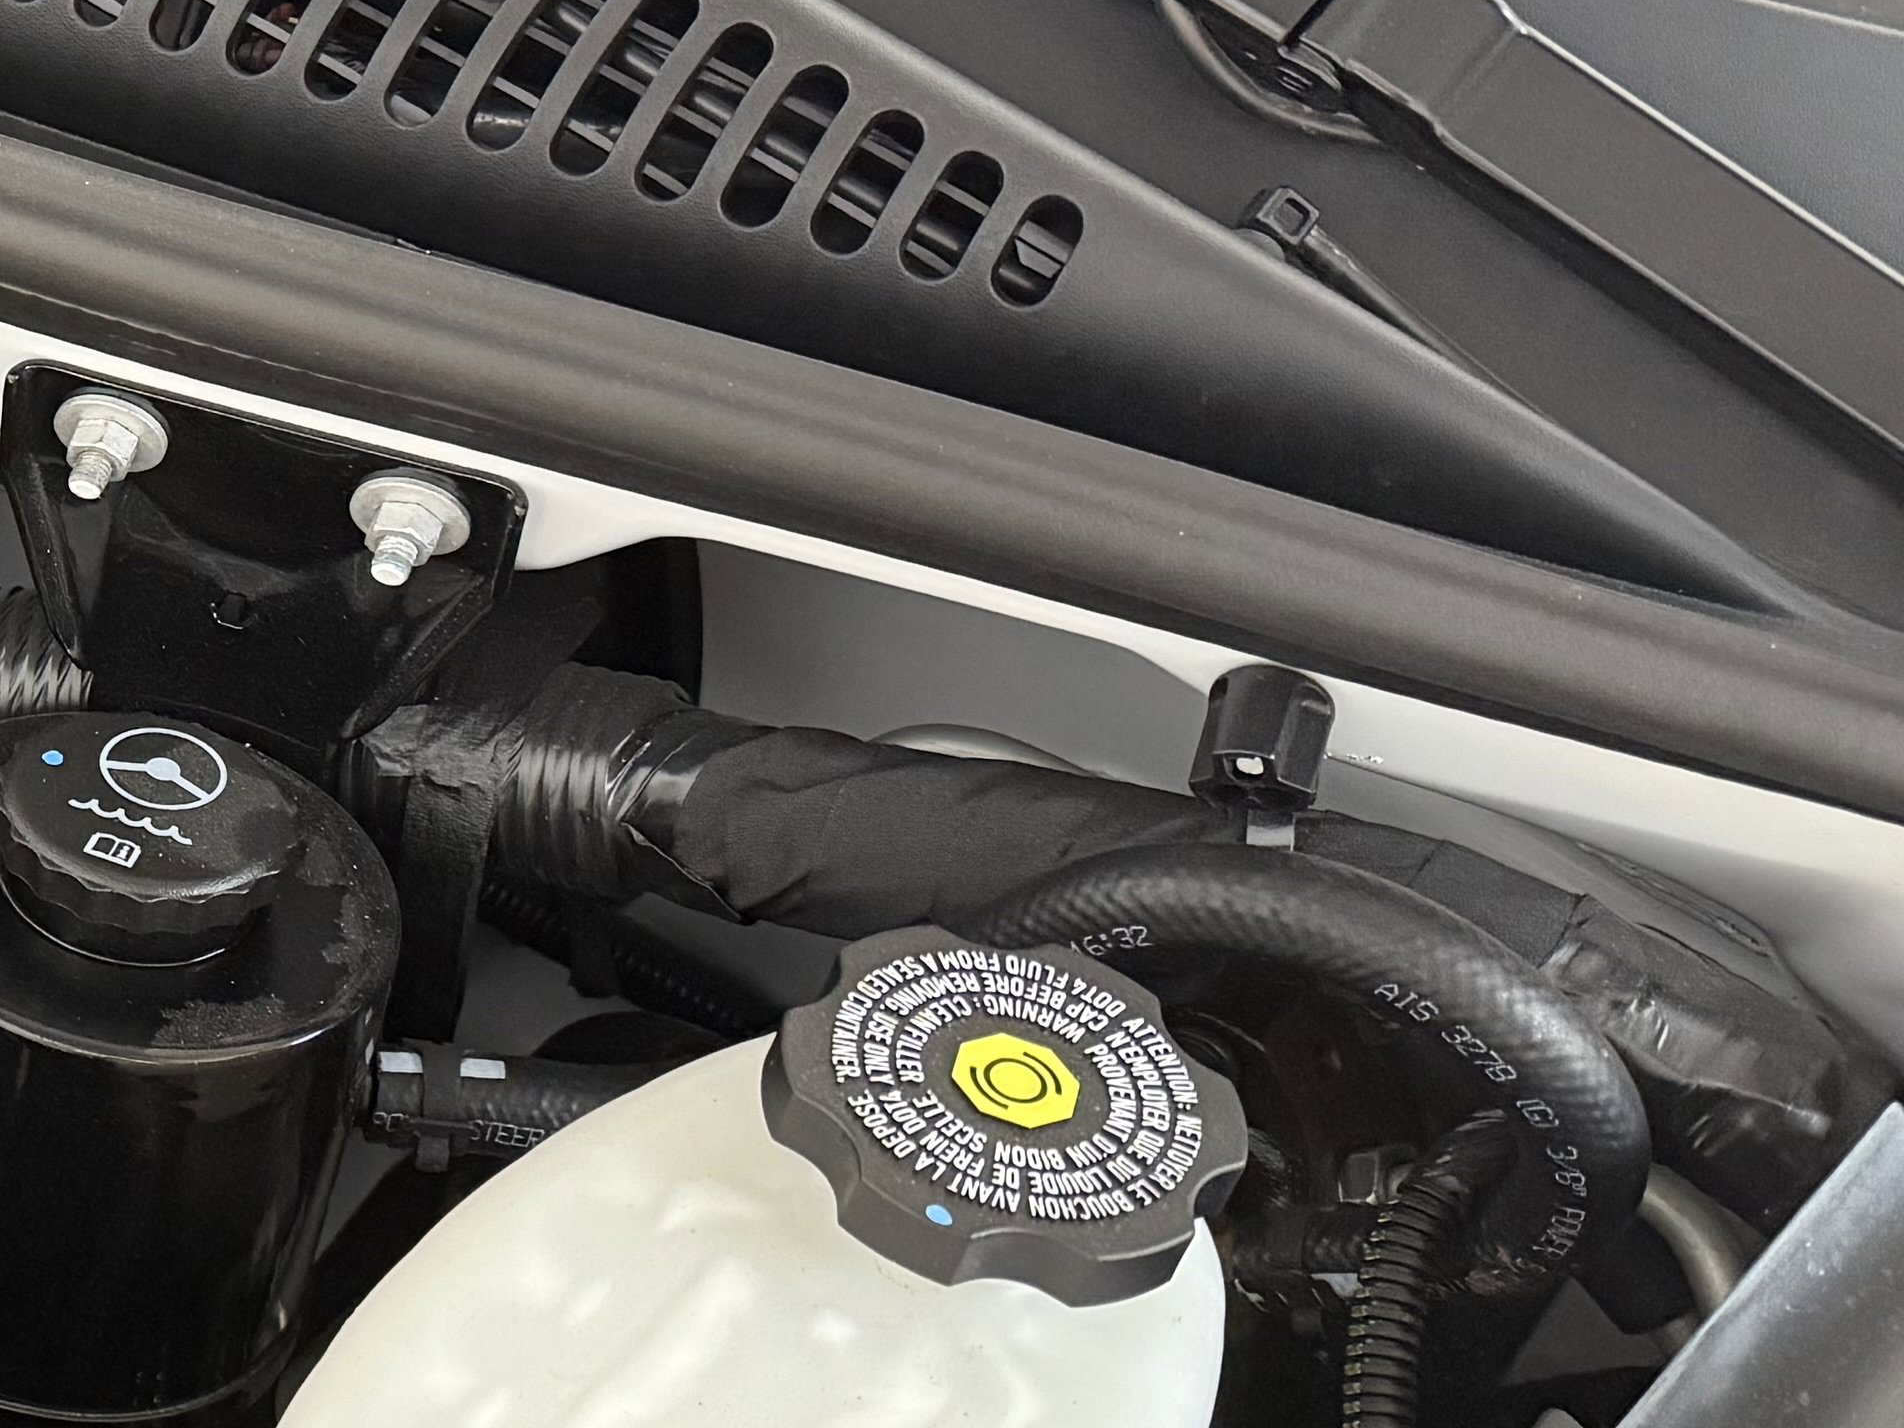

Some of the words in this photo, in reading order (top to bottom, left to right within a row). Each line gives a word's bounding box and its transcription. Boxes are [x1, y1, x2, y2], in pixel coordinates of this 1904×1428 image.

[856, 956, 925, 1000] SEALED
[920, 952, 938, 973] A
[937, 949, 1001, 972] FROM
[1005, 954, 1070, 990] FLUID
[879, 972, 981, 1016] REMOVING.
[982, 972, 1067, 1011] BEFORE
[1071, 977, 1127, 1018] DOT4
[864, 1011, 899, 1045] USE
[909, 994, 973, 1035] CLEAN
[1065, 1001, 1109, 1032] CAP
[831, 991, 873, 1084] CONTAINER.
[895, 1025, 929, 1083] FILLER
[1441, 1024, 1518, 1083] 3278
[863, 1042, 896, 1086] ONLY
[1104, 1031, 1171, 1132] N'EMPLOYER
[1121, 1018, 1198, 1110] ATTENTION:
[879, 1090, 927, 1135] DOT4
[1084, 1043, 1137, 1143] PROVENANT
[914, 1151, 947, 1181] LA
[919, 1130, 985, 1177] FREIN
[994, 1140, 1066, 1171] BIDON
[1065, 1133, 1118, 1169] D'UN
[1126, 1129, 1165, 1166] QUE
[1149, 1113, 1203, 1191] NETTOYER
[992, 1162, 1020, 1190] DE
[1028, 1165, 1112, 1195] LIQUIDE
[1106, 1154, 1141, 1183] DU
[946, 1172, 1021, 1213] AVANT
[1028, 1189, 1135, 1220] BOUCHON
[1127, 1178, 1161, 1206] LE
